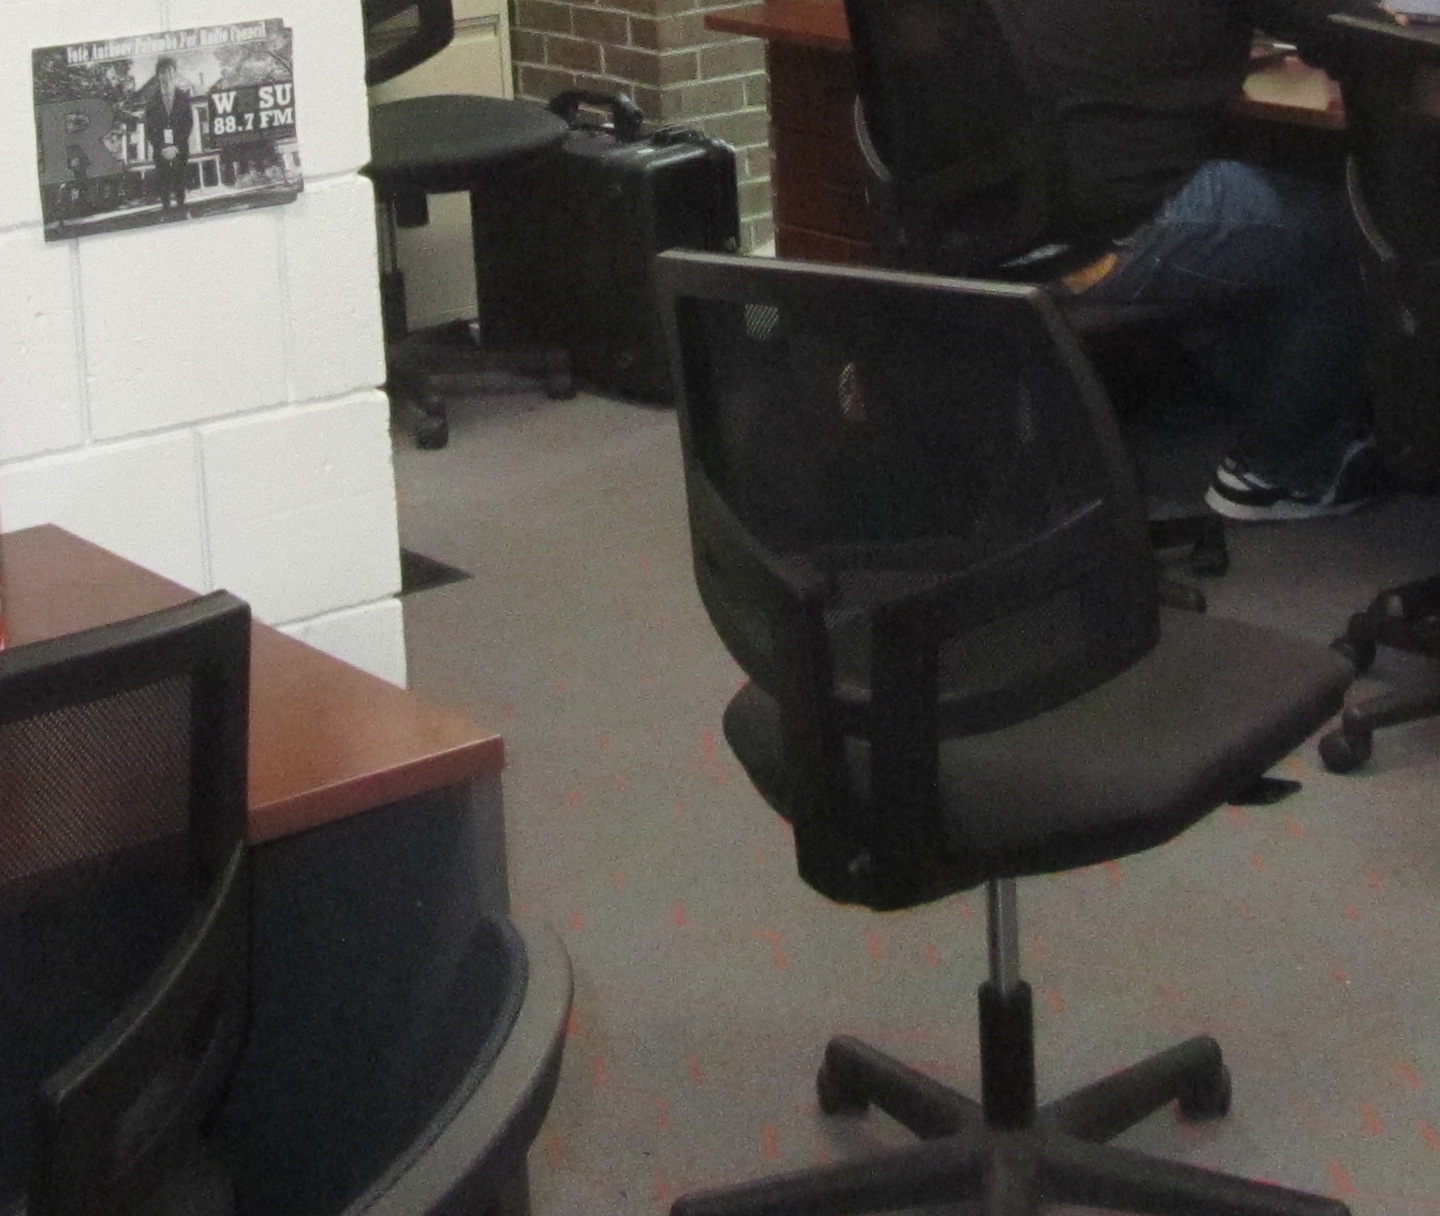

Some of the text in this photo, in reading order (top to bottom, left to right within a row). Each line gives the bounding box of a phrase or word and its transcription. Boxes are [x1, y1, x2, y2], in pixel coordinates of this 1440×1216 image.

[212, 83, 293, 113] WSU
[214, 107, 294, 135] 88.7 FM
